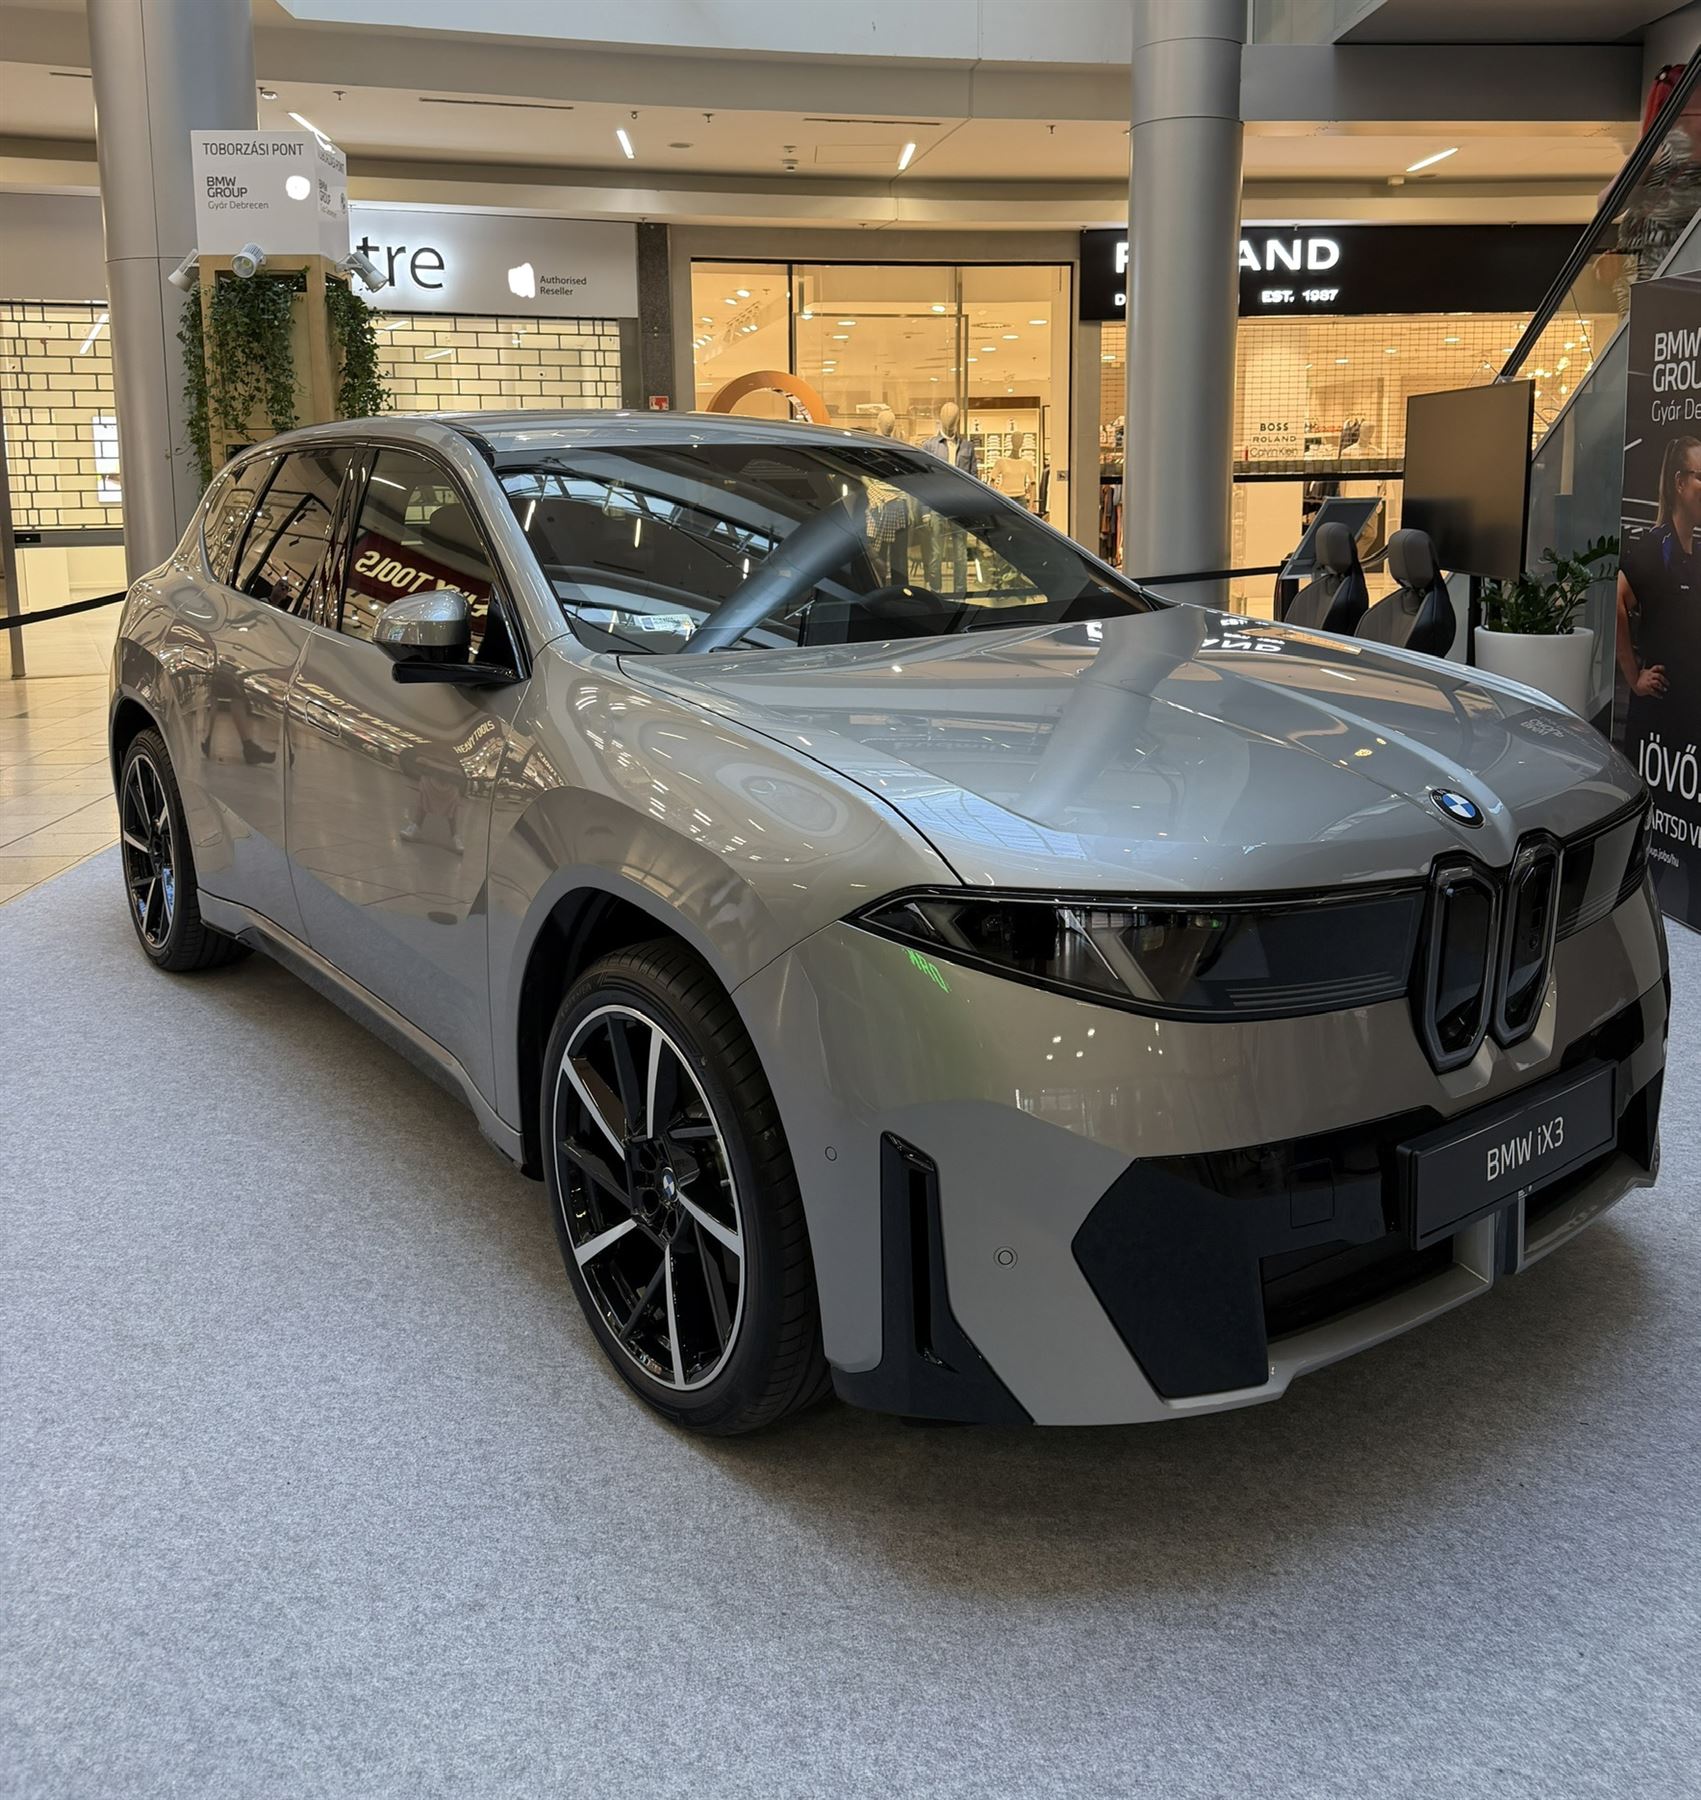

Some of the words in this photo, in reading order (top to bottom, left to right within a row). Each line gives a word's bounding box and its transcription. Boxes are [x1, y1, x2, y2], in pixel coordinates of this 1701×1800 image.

[203, 141, 269, 155] TOBORZÁSI
[272, 143, 304, 155] PONT
[206, 176, 236, 187] BMW
[207, 187, 248, 198] GROUP
[208, 201, 228, 211] Gyár
[230, 201, 269, 209] Debrecen
[356, 236, 444, 289] tre
[540, 275, 587, 286] Authorised
[540, 286, 574, 296] Reseller
[1654, 327, 1701, 361] BMW
[1653, 360, 1701, 392] GROU
[1651, 399, 1681, 426] Gyár
[1684, 398, 1701, 420] De
[1260, 423, 1289, 431] BOSS
[1486, 1130, 1533, 1182] BMW
[1537, 1116, 1564, 1156] iX3
